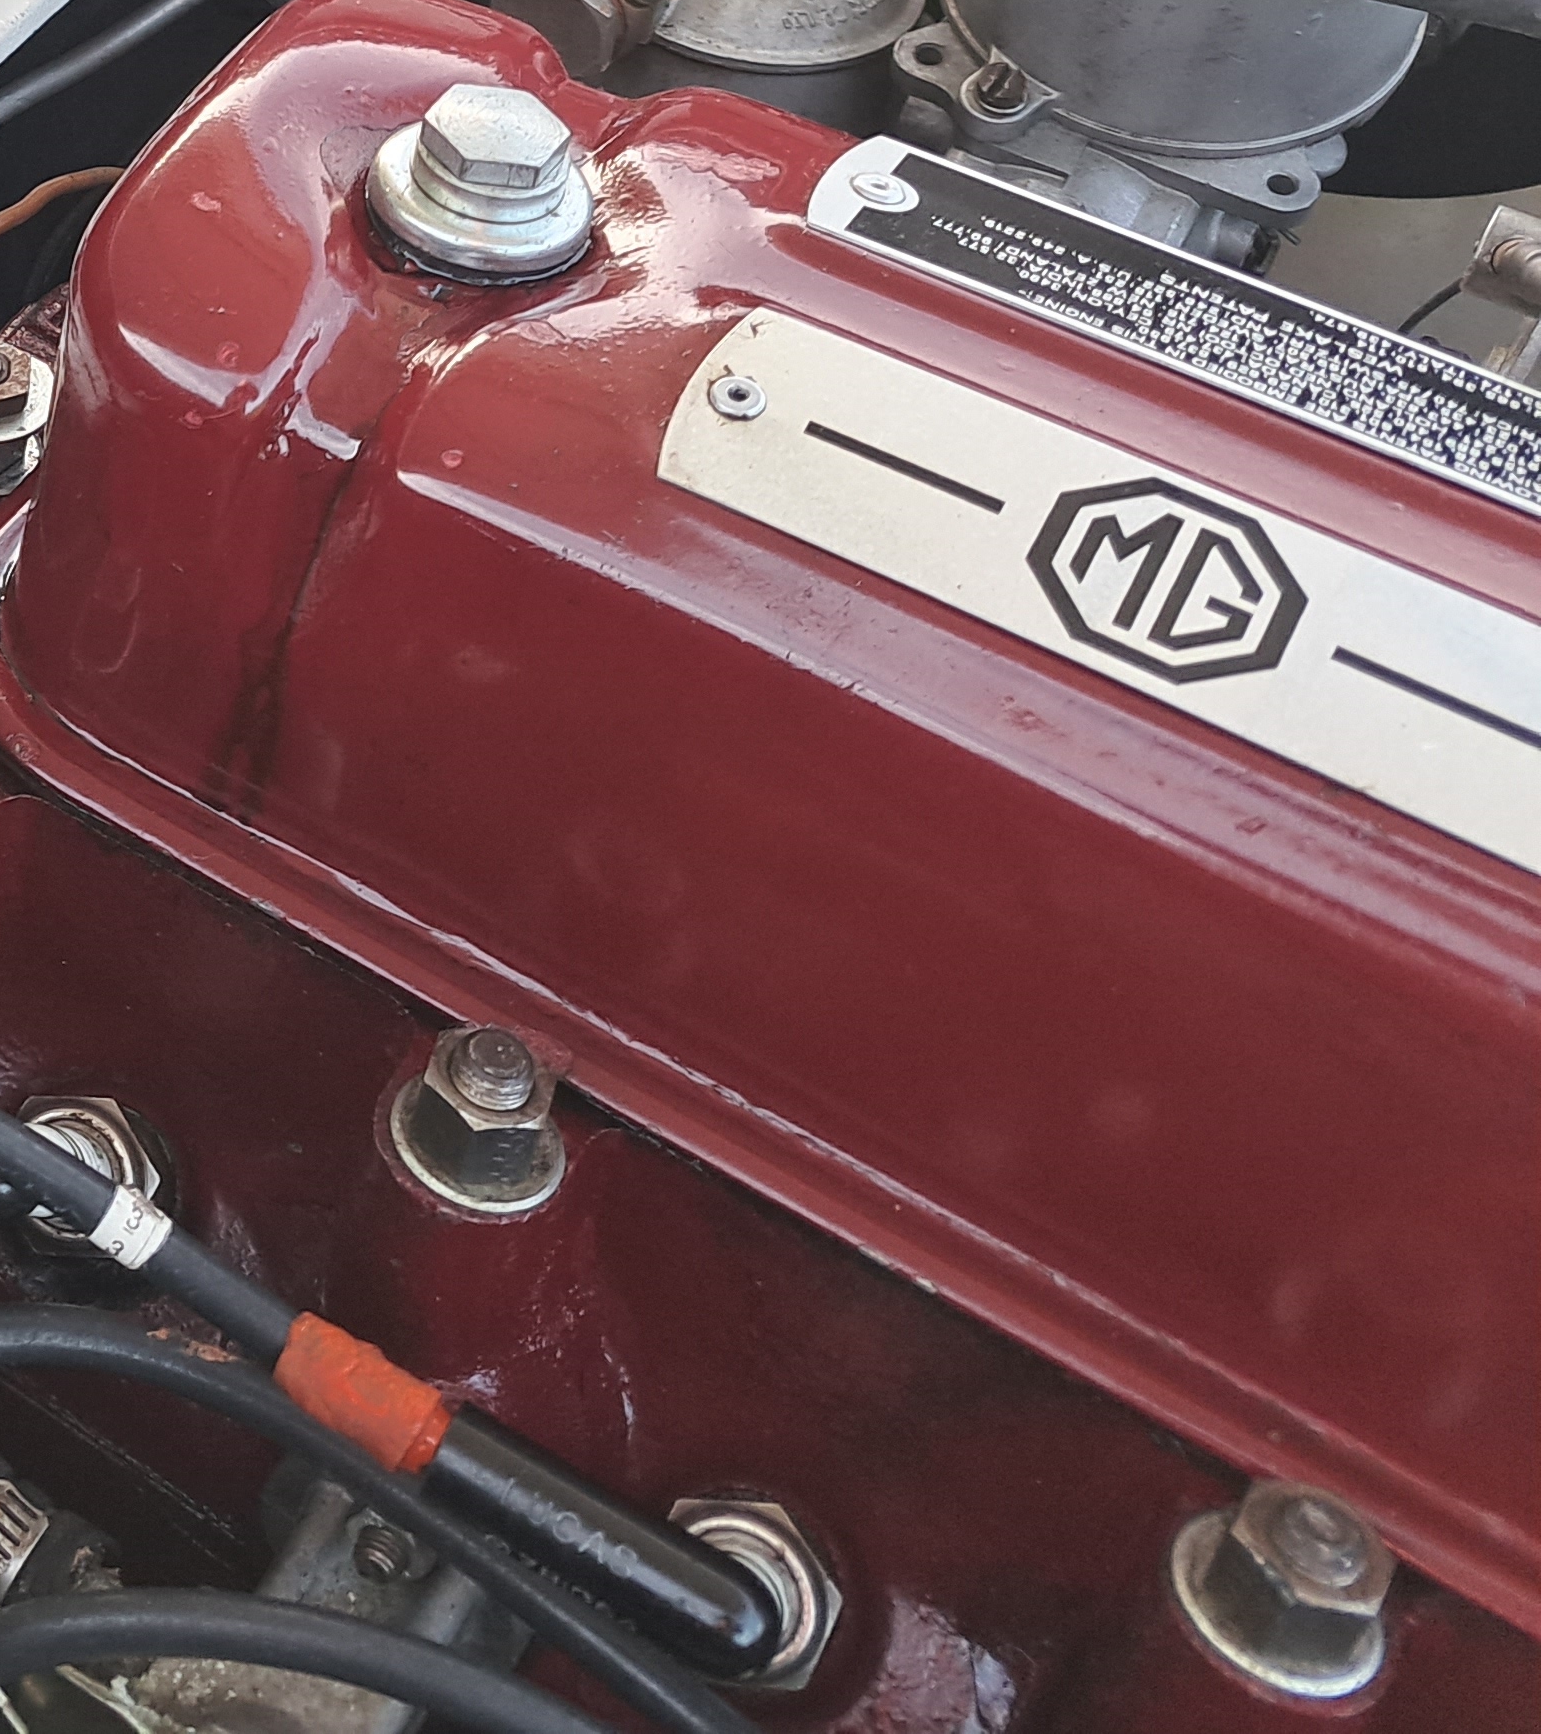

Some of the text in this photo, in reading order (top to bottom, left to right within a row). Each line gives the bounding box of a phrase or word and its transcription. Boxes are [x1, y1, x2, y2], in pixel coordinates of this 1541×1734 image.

[1157, 268, 1270, 325] PATENTS
[1109, 321, 1159, 350] THIS
[1163, 344, 1186, 361] IN
[1278, 316, 1405, 378] WESLAKE
[1190, 353, 1297, 405] EMBODIED
[1303, 399, 1347, 424] ARE
[1350, 416, 1449, 466] PATENTS
[1067, 511, 1264, 652] MG
[499, 1475, 638, 1579] LUCAS
